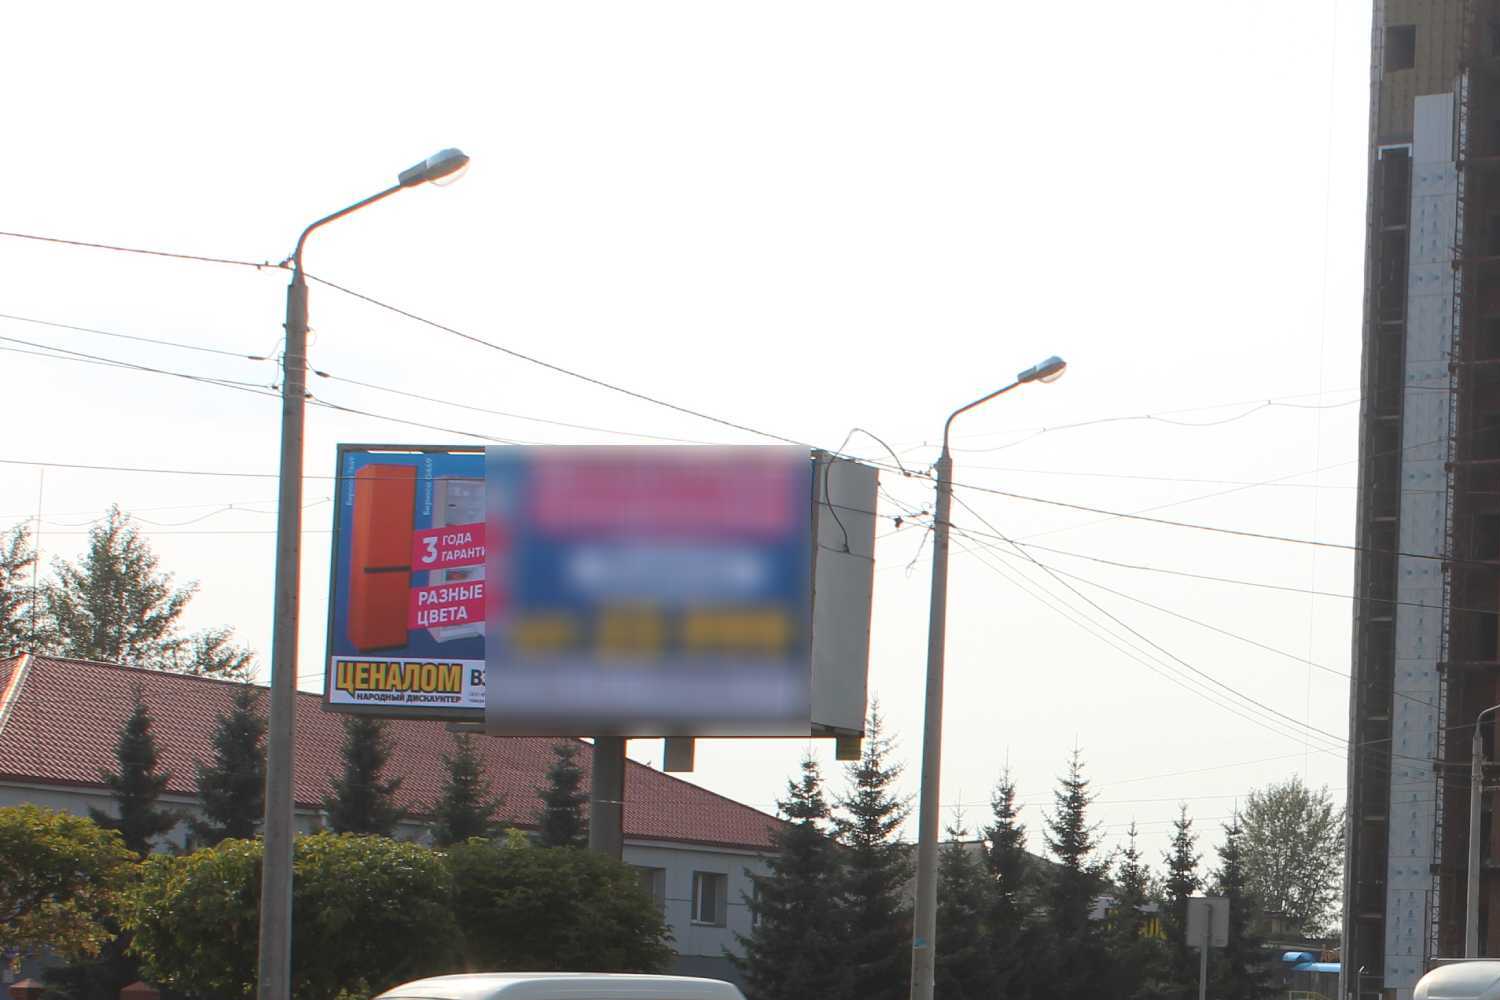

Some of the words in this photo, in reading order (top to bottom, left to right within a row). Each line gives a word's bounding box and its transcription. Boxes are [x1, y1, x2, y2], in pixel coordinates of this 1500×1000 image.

[421, 536, 438, 564] 3
[442, 532, 472, 546] ГОДА
[418, 584, 483, 606] РАЗНЫЕ
[417, 606, 468, 627] ЦВЕТА
[336, 660, 463, 696] ЦЕНАЛОМ
[356, 692, 404, 703] НАРОДНЫЙ
[405, 693, 462, 704] ДИСКАУНТЕР
